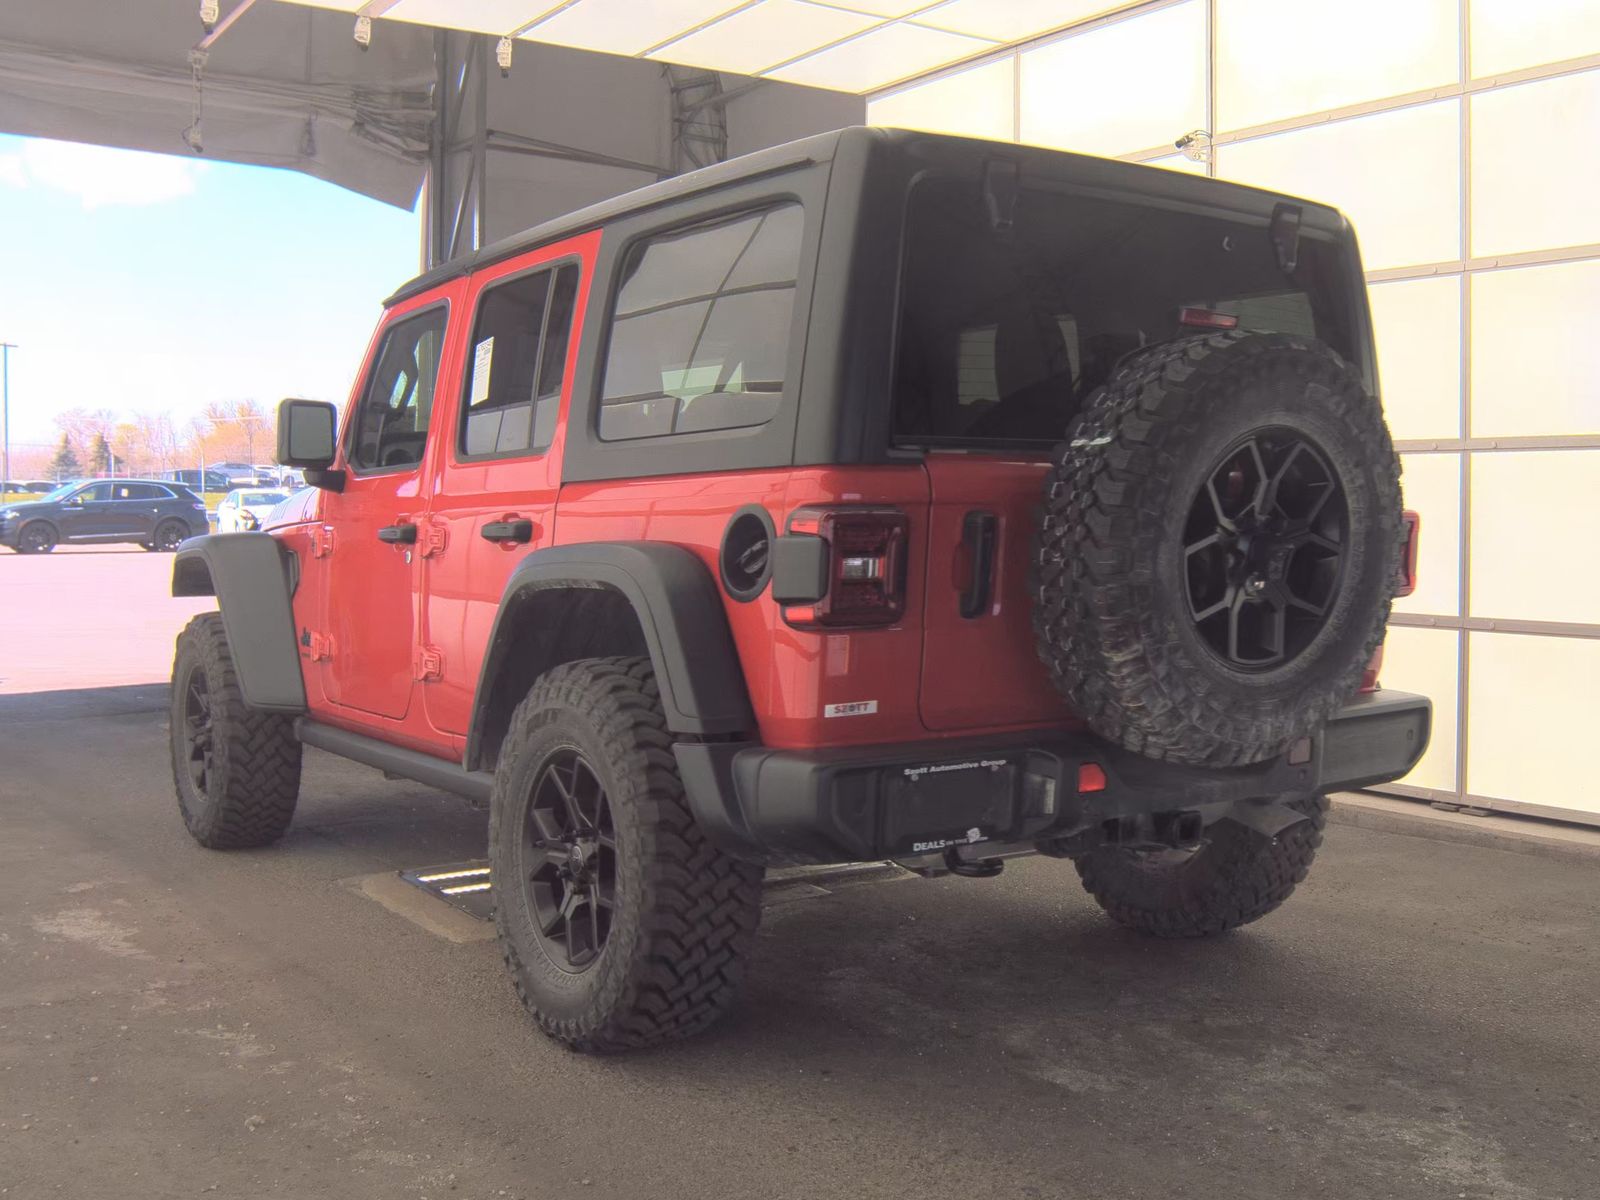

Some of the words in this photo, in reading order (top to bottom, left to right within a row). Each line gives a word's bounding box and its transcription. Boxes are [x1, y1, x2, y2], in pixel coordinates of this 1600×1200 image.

[834, 703, 869, 714] SZOTT
[904, 767, 928, 775] Szott
[929, 762, 979, 773] Automotive
[913, 839, 946, 852] DEALS
